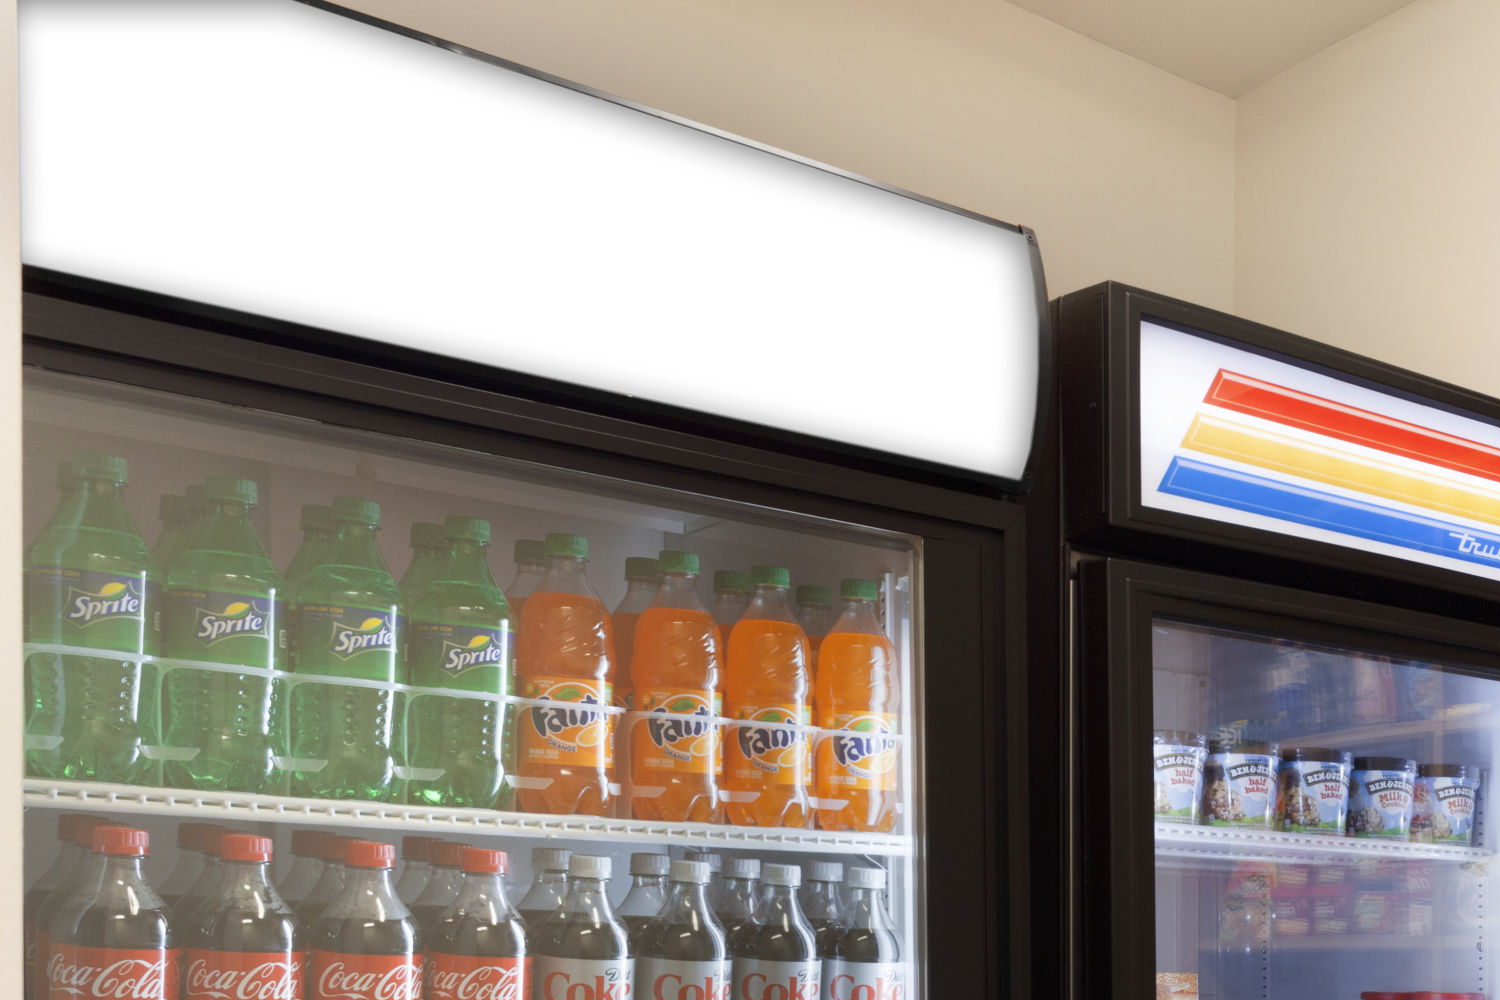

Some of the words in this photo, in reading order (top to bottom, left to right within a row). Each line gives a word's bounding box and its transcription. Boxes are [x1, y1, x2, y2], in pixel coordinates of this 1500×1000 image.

[70, 593, 140, 621] Sprite
[198, 613, 263, 639] Sprite
[334, 623, 393, 653] Sprite
[446, 640, 501, 671] Sprite
[547, 738, 577, 753] ORANGE
[663, 748, 691, 762] ORANGE
[752, 760, 779, 773] ORANGE
[47, 952, 169, 999] Coca-Cola
[186, 959, 300, 1000] Coca-Cola
[318, 962, 422, 1000] Coca-Cola
